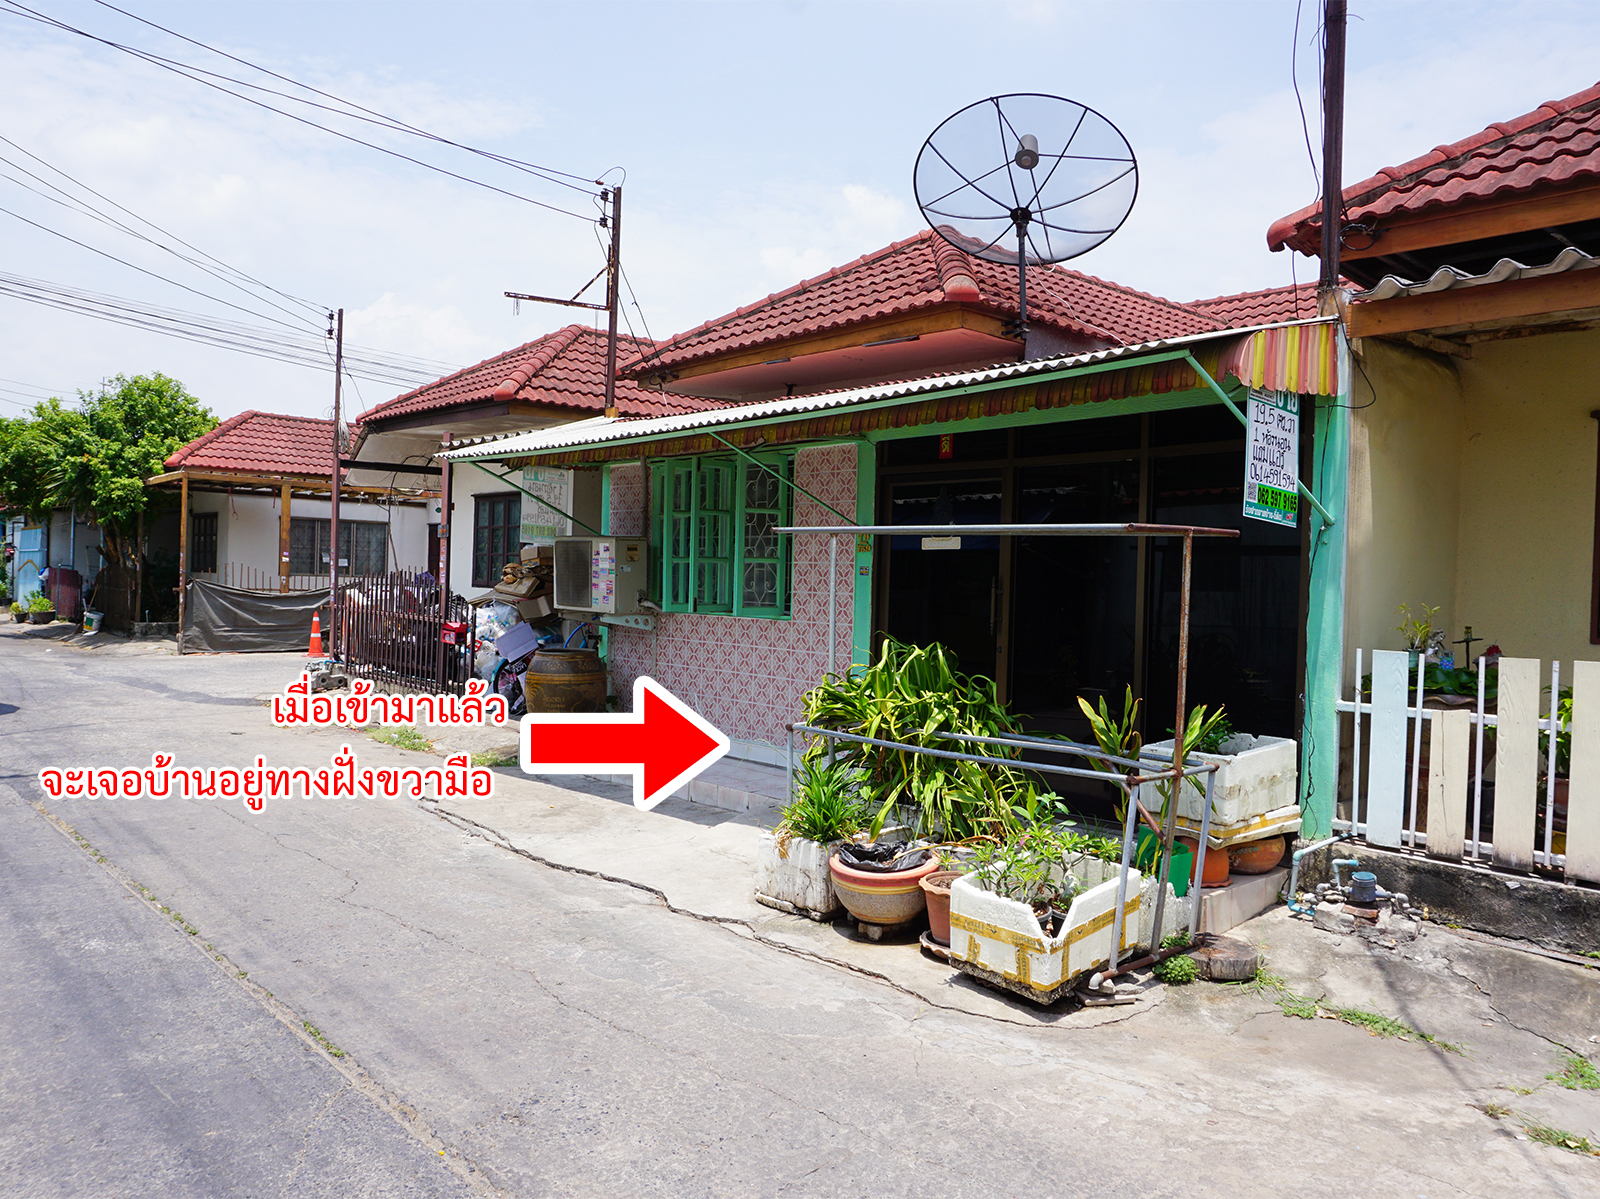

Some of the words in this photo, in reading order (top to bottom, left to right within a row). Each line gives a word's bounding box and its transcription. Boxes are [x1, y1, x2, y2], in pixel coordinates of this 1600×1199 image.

[1254, 402, 1275, 425] 19.5
[1253, 427, 1259, 442] 1
[1262, 428, 1291, 451] ห้องนอน
[1250, 462, 1296, 491] 0614591594
[1258, 486, 1270, 506] 062
[1271, 489, 1282, 508] 597
[1283, 493, 1297, 512] 9165
